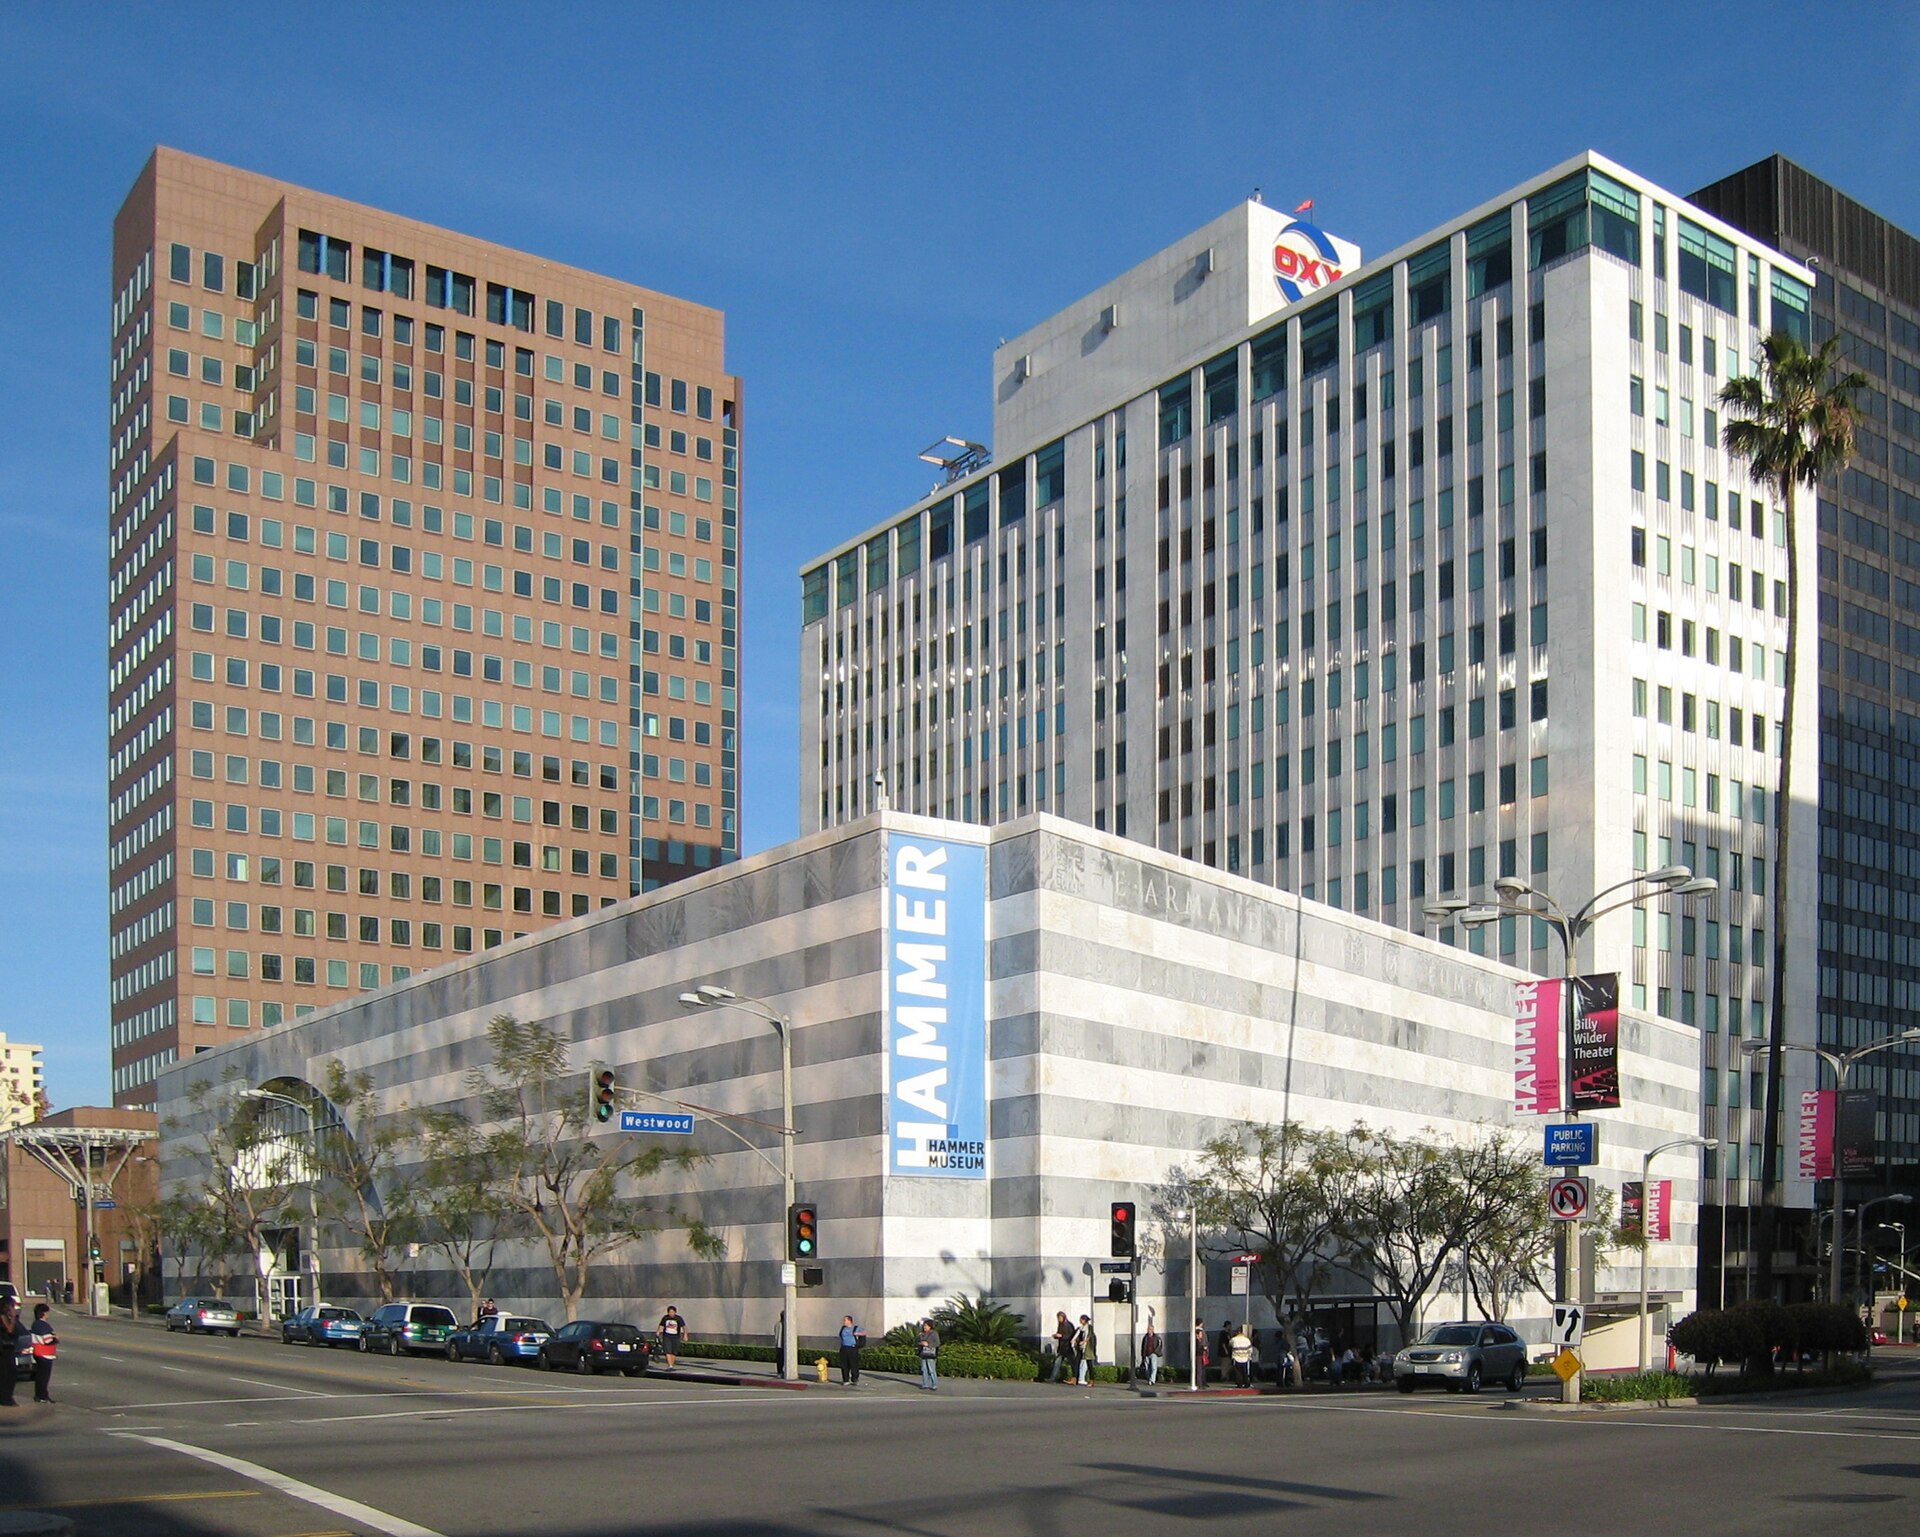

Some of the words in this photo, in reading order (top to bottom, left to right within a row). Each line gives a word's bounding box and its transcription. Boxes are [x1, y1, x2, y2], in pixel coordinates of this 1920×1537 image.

[1275, 245, 1343, 287] OXY
[896, 845, 948, 1168] HAMMER
[1574, 1018, 1598, 1032] Billy
[1573, 1032, 1607, 1045] Wilder
[1515, 981, 1539, 1115] HAMMER
[1573, 1046, 1614, 1059] Theater
[625, 1115, 689, 1129] Westwood
[1553, 1129, 1583, 1141] PUBLIC
[1800, 1090, 1819, 1180] HAMMER
[928, 1139, 985, 1154] HAMMER
[1550, 1142, 1586, 1153] PARKING
[928, 1155, 985, 1169] MUSEUM
[1647, 1181, 1661, 1241] HAMMER
